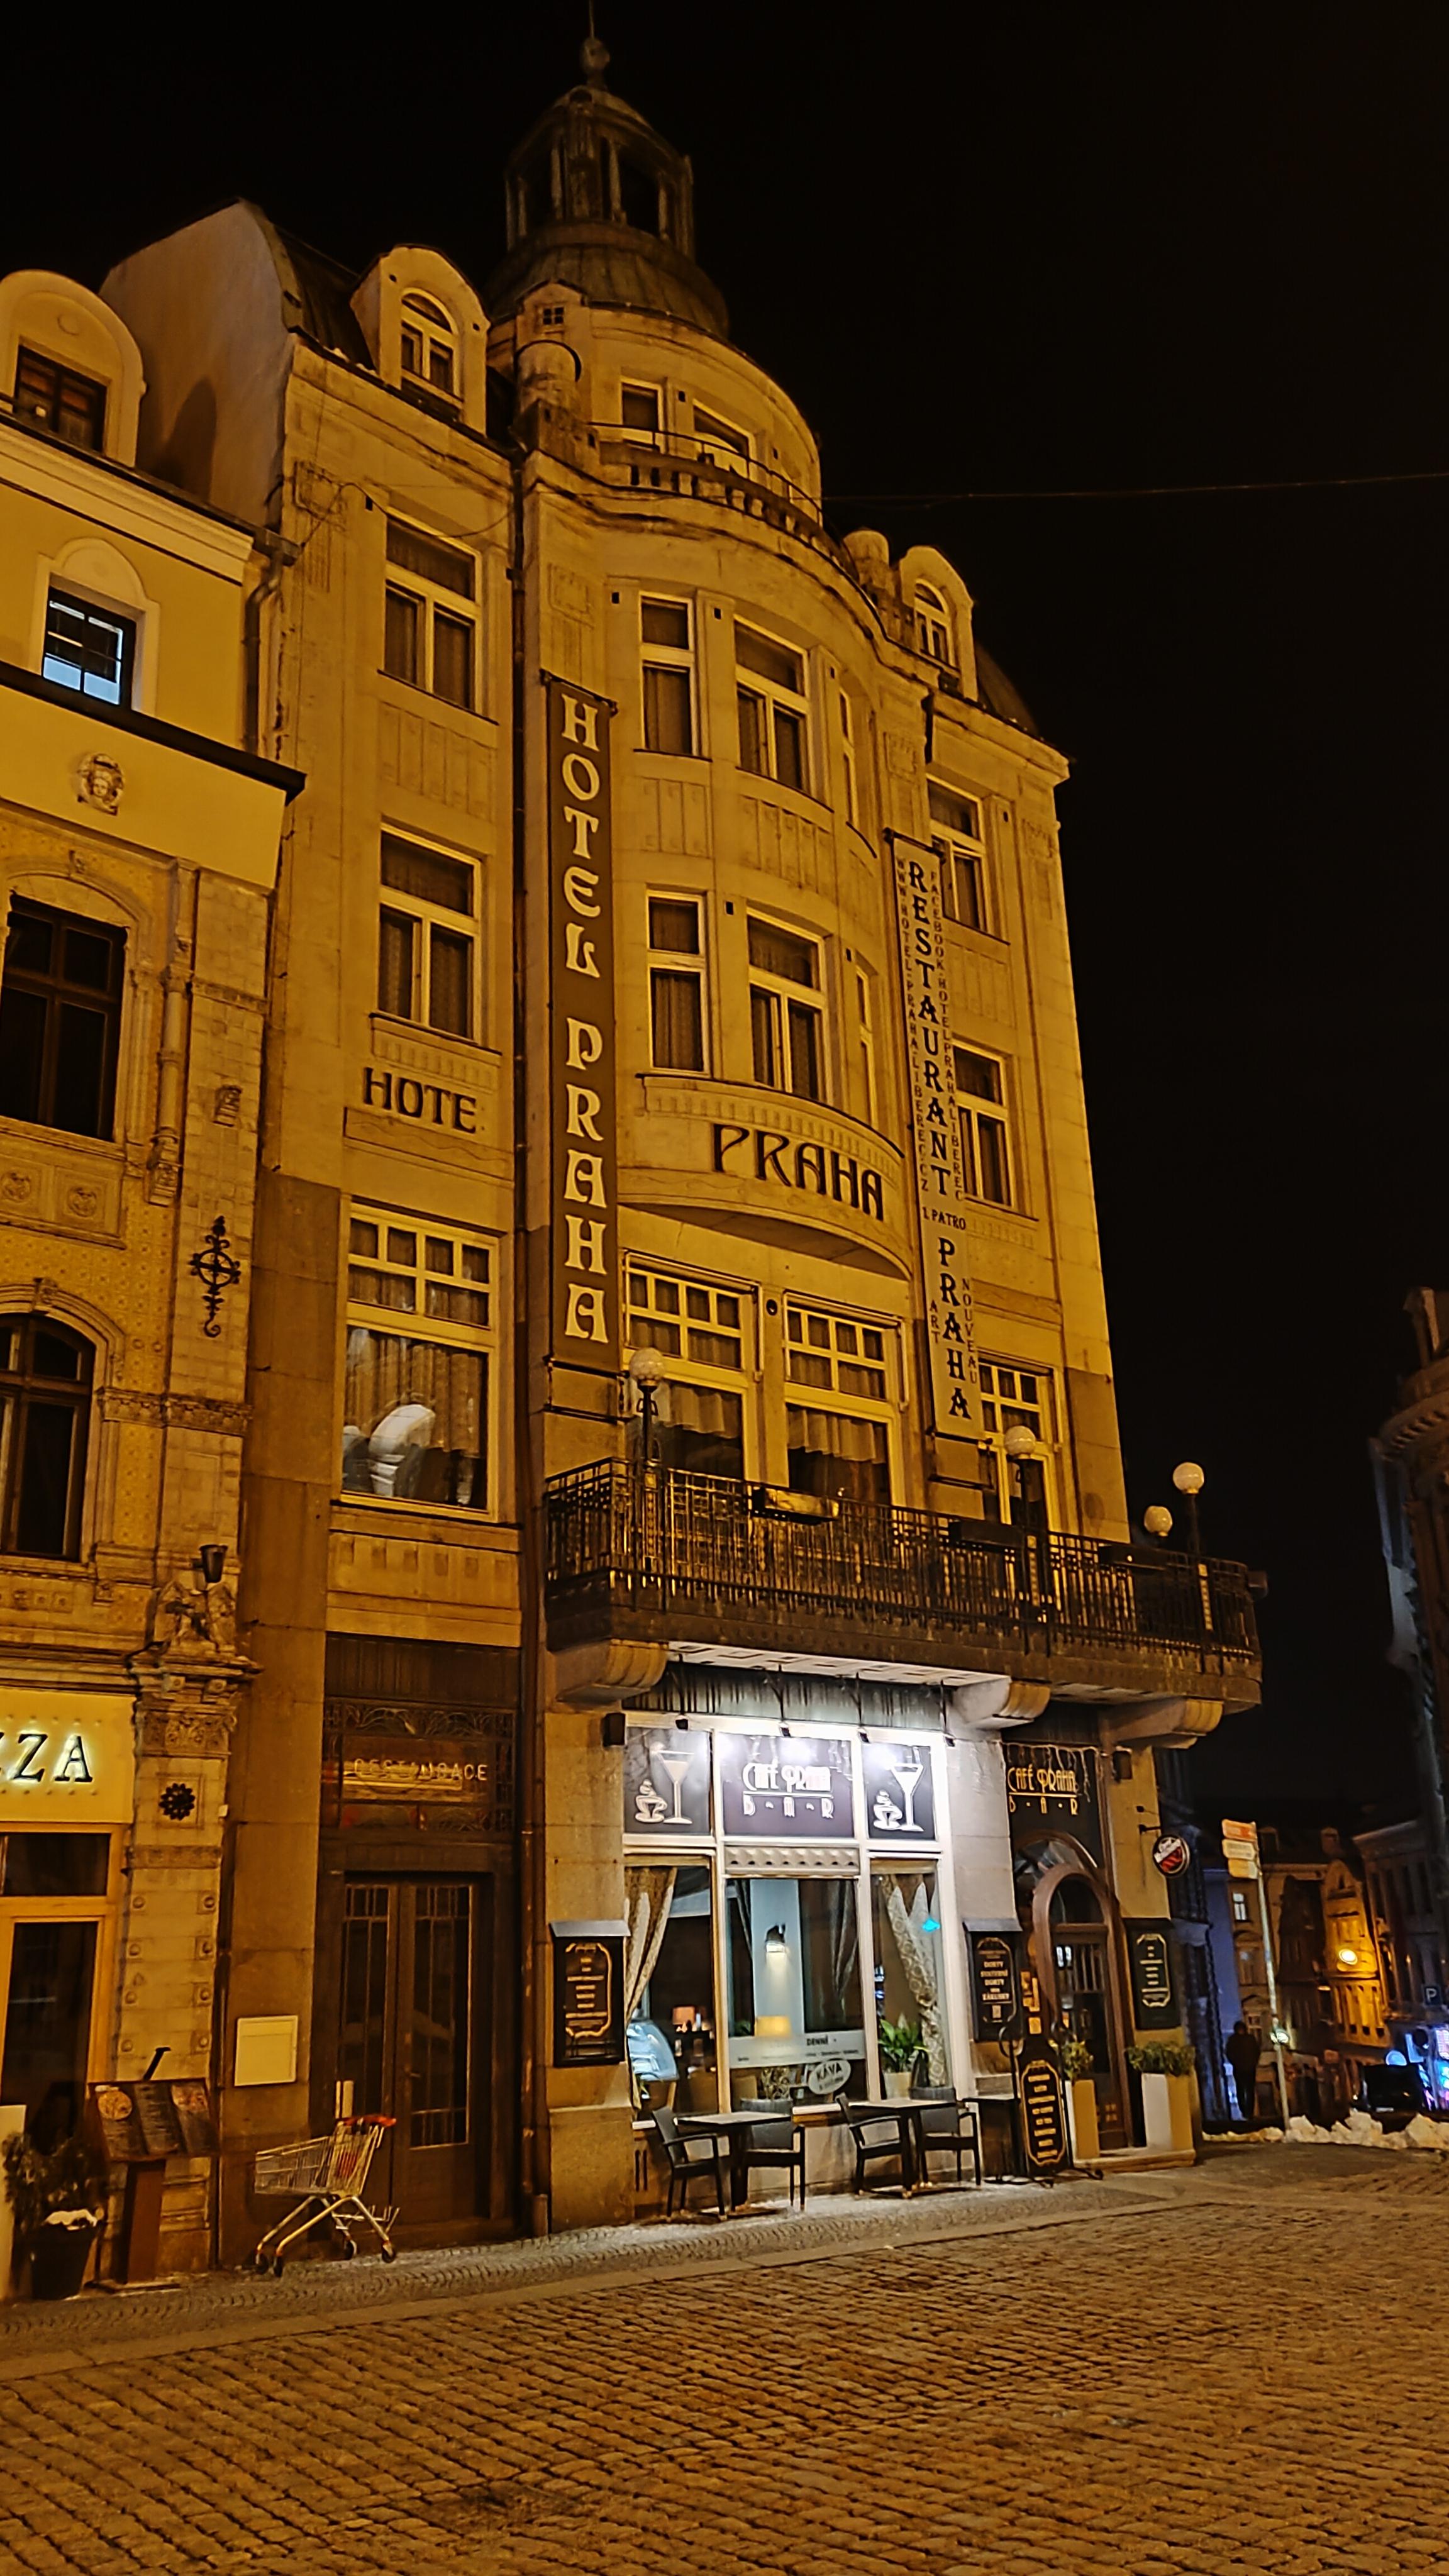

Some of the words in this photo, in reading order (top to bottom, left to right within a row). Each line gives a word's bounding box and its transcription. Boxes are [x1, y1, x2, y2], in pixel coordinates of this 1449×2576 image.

[562, 693, 601, 979] HOTEL
[909, 860, 952, 1196] RESTAURANT
[363, 1067, 477, 1134] HOTE
[564, 1016, 609, 1344] PRAHA
[712, 1123, 884, 1221] PRAHA
[931, 1208, 967, 1231] PATRO
[929, 1299, 941, 1344] ART
[938, 1236, 972, 1420] PRAHA
[962, 1277, 977, 1384] NOUVEAU
[0, 1731, 93, 1782] ZA
[1426, 1987, 1437, 2003] P
